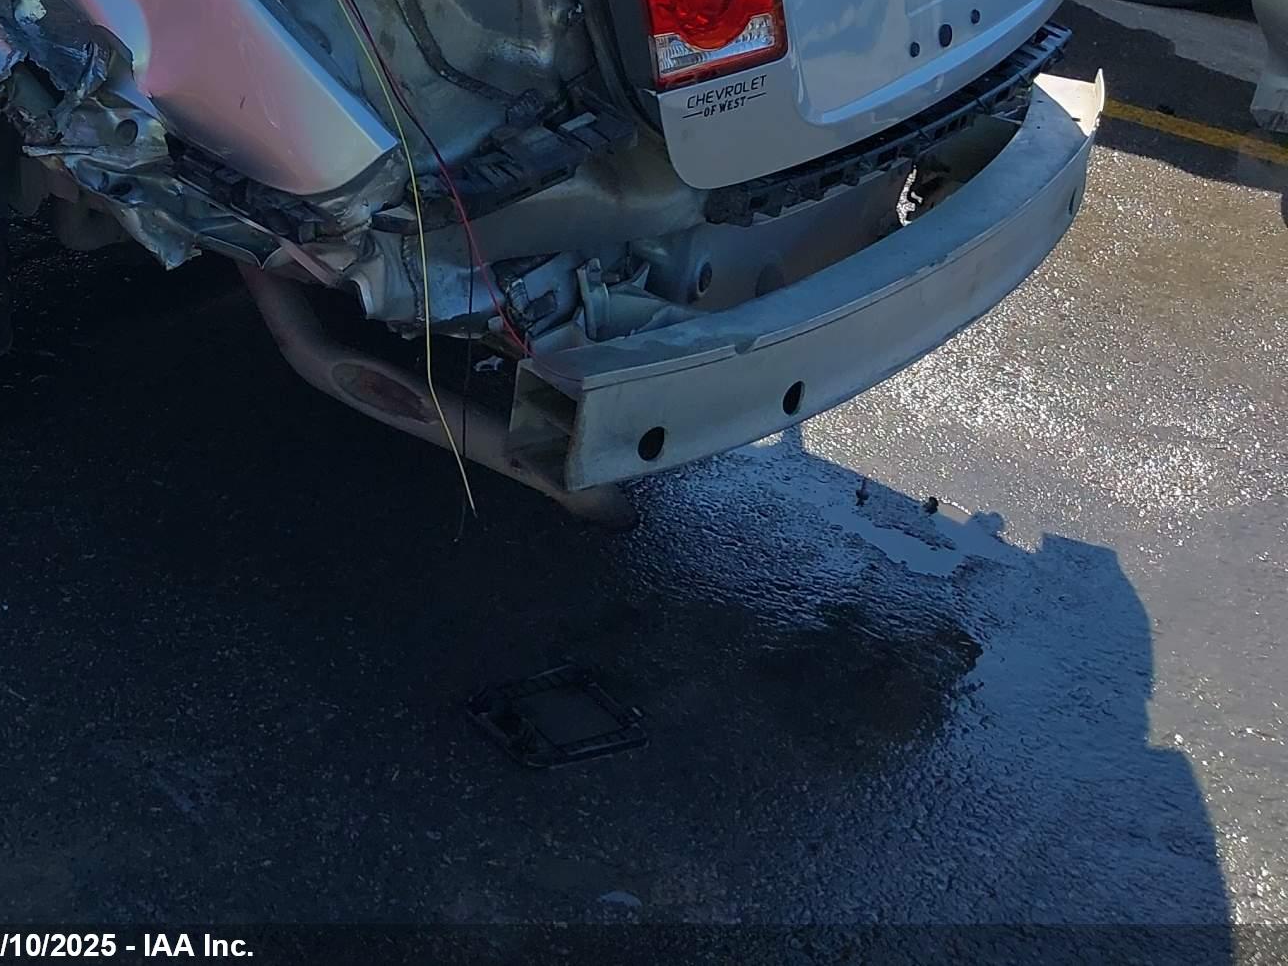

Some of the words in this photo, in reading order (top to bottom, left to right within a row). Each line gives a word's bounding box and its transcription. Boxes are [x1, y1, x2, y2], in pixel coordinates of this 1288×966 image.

[687, 74, 767, 109] CHEVROLET
[703, 104, 717, 117] OF
[719, 95, 746, 113] WEST
